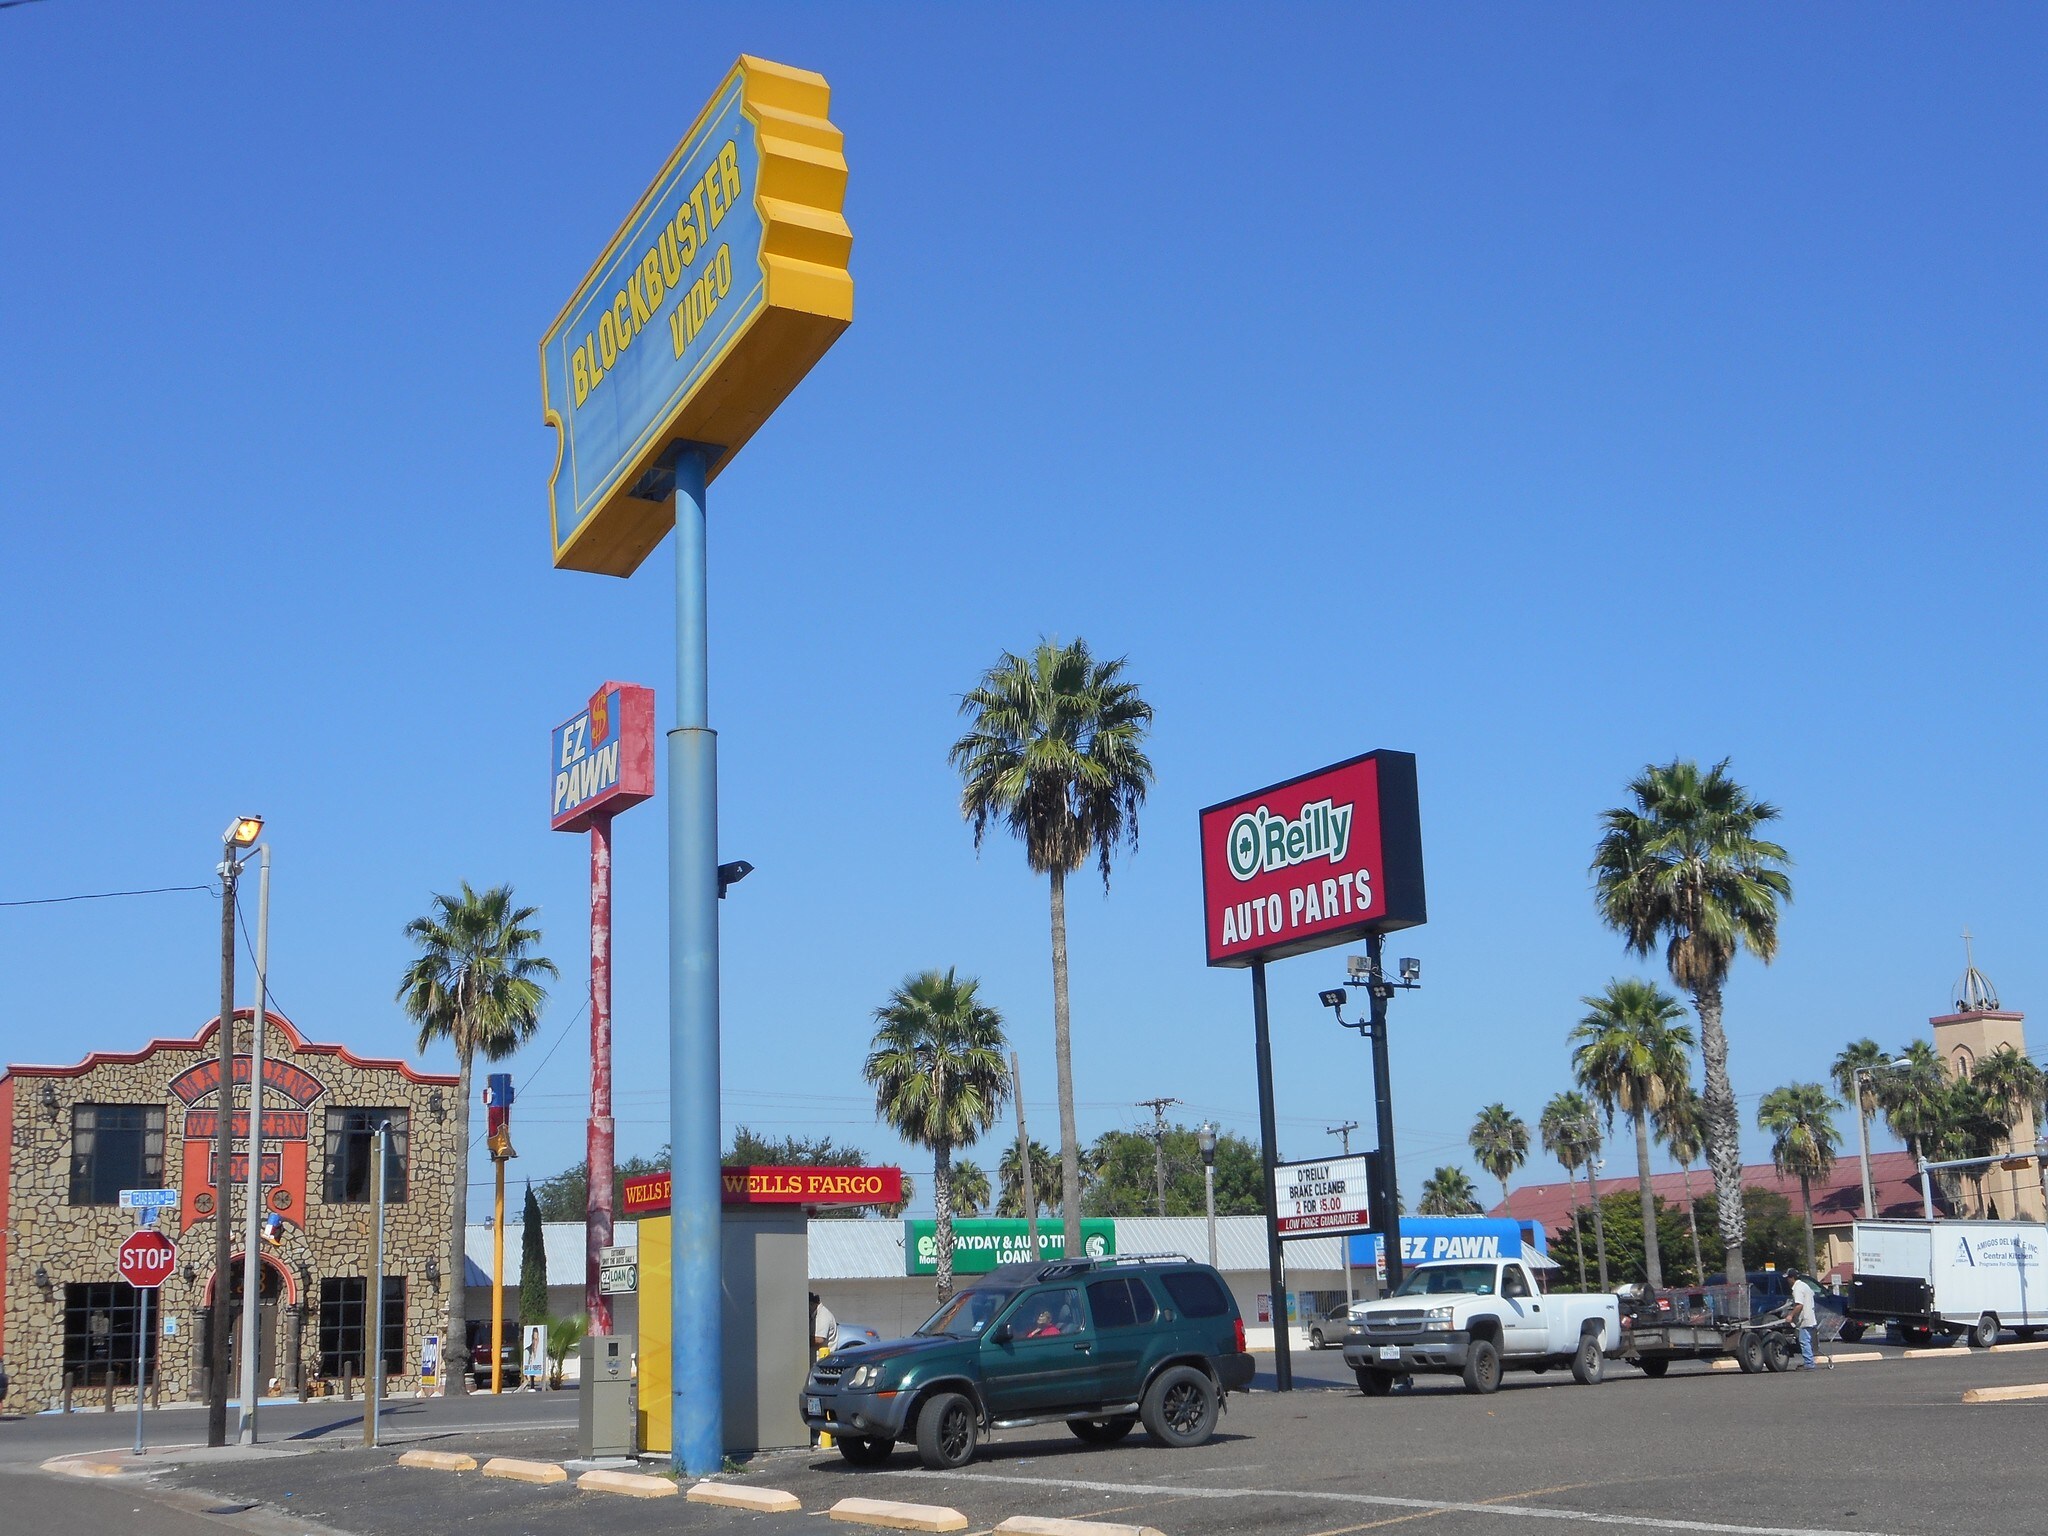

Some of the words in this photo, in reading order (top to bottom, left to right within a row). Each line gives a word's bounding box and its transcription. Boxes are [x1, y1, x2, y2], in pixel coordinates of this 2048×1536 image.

[570, 138, 742, 410] BLOCKBUSTER
[669, 242, 732, 361] VIDEO
[561, 714, 589, 769] EZ
[553, 740, 619, 816] PAWN
[1228, 800, 1352, 880] O'Reilly
[1222, 893, 1283, 946] AUTO
[1289, 869, 1372, 928] PARTS
[186, 1112, 307, 1136] WSTERN
[722, 1176, 802, 1194] WELLS
[807, 1176, 882, 1194] FARGO
[1298, 1166, 1330, 1182] O'REILLY
[625, 1181, 662, 1204] WELLS
[1290, 1184, 1313, 1198] BRAKE
[1315, 1180, 1346, 1196] CLEANER
[1296, 1202, 1301, 1214] 2
[1304, 1200, 1316, 1213] FOR
[1320, 1197, 1342, 1211] $5.00
[1286, 1218, 1300, 1230] LOW
[1300, 1216, 1319, 1228] PRICE
[1321, 1212, 1358, 1226] GUARANTEE
[951, 1236, 1000, 1250] PAYDAY
[1002, 1235, 1012, 1249] &
[1014, 1234, 1048, 1249] AUO
[1050, 1234, 1065, 1248] TIT
[1400, 1237, 1428, 1259] EZ
[1433, 1236, 1498, 1259] PAWN
[1976, 1238, 1998, 1251] AMIGOS
[122, 1248, 172, 1270] STOP
[919, 1256, 937, 1264] Mon
[611, 1269, 626, 1282] LOAN
